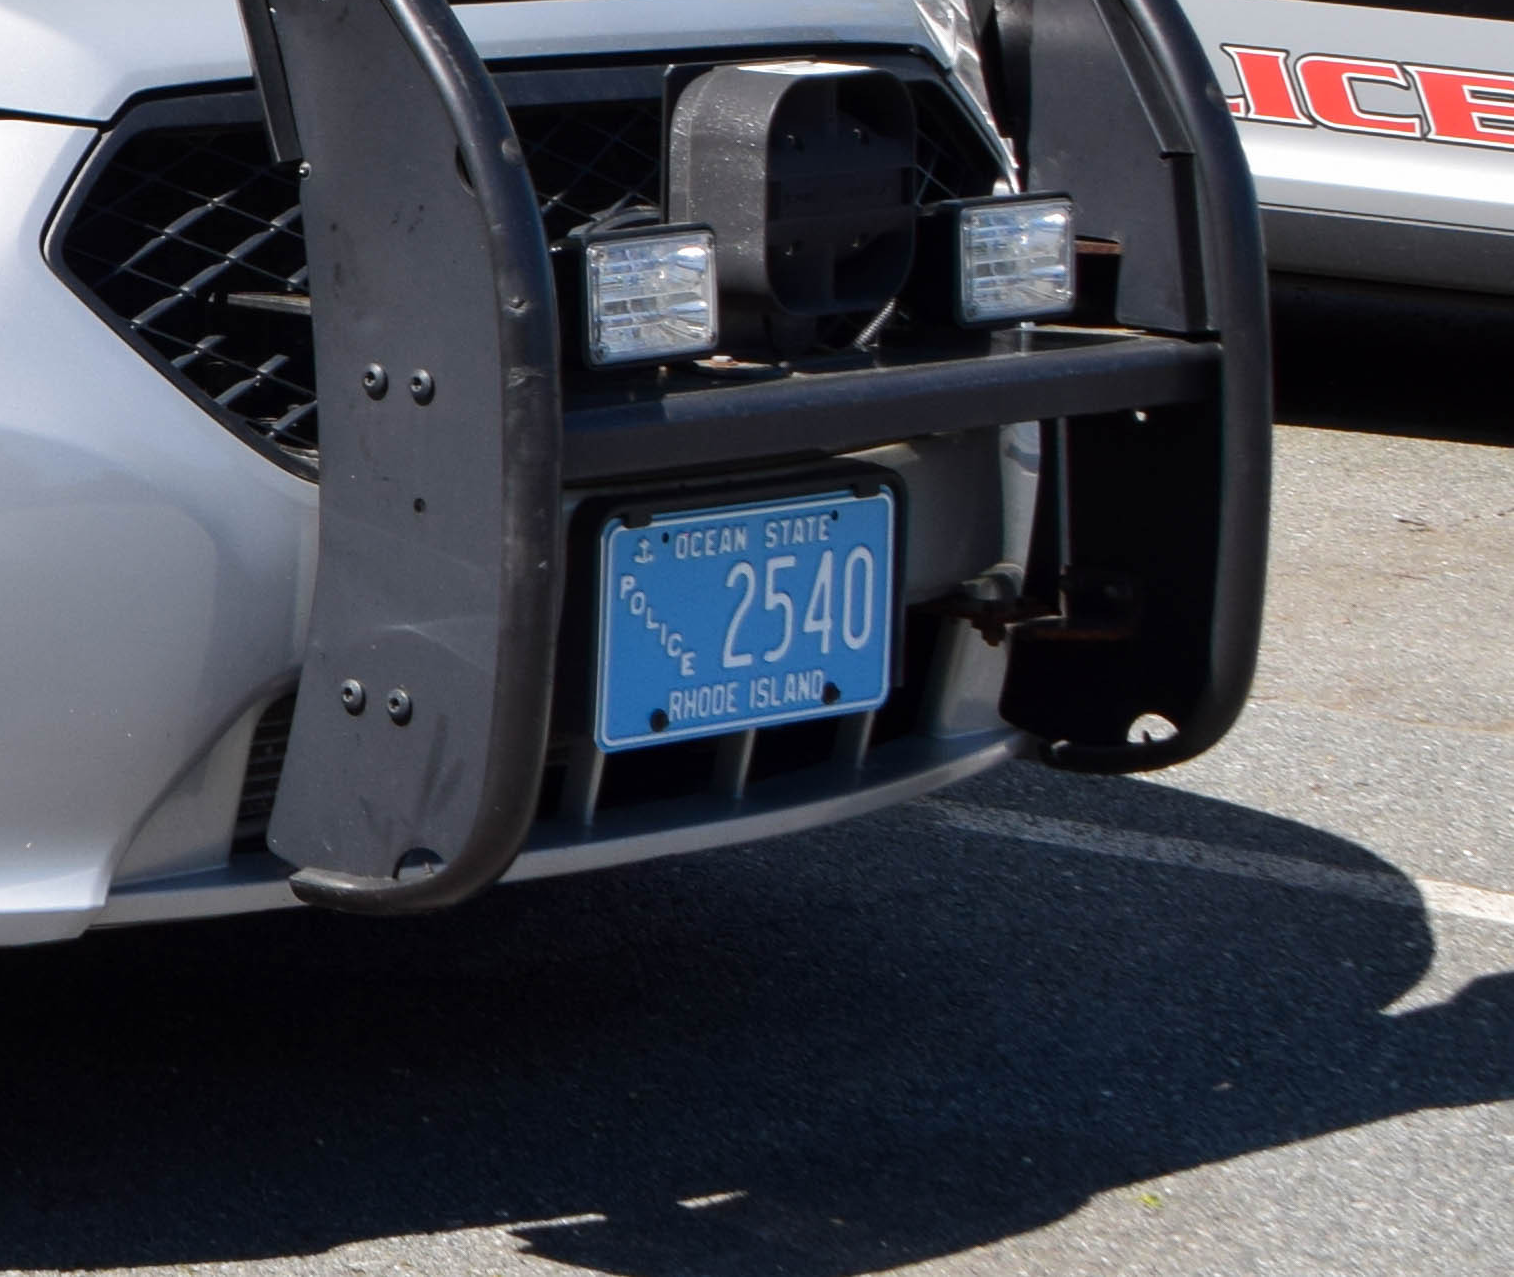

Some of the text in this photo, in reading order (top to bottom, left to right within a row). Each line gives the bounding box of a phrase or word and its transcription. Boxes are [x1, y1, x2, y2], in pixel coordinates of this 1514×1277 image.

[675, 513, 830, 560] OCEAN STATE
[619, 574, 697, 677] POLICE
[722, 544, 875, 669] 2540
[668, 668, 826, 721] RHODE ISLAND
